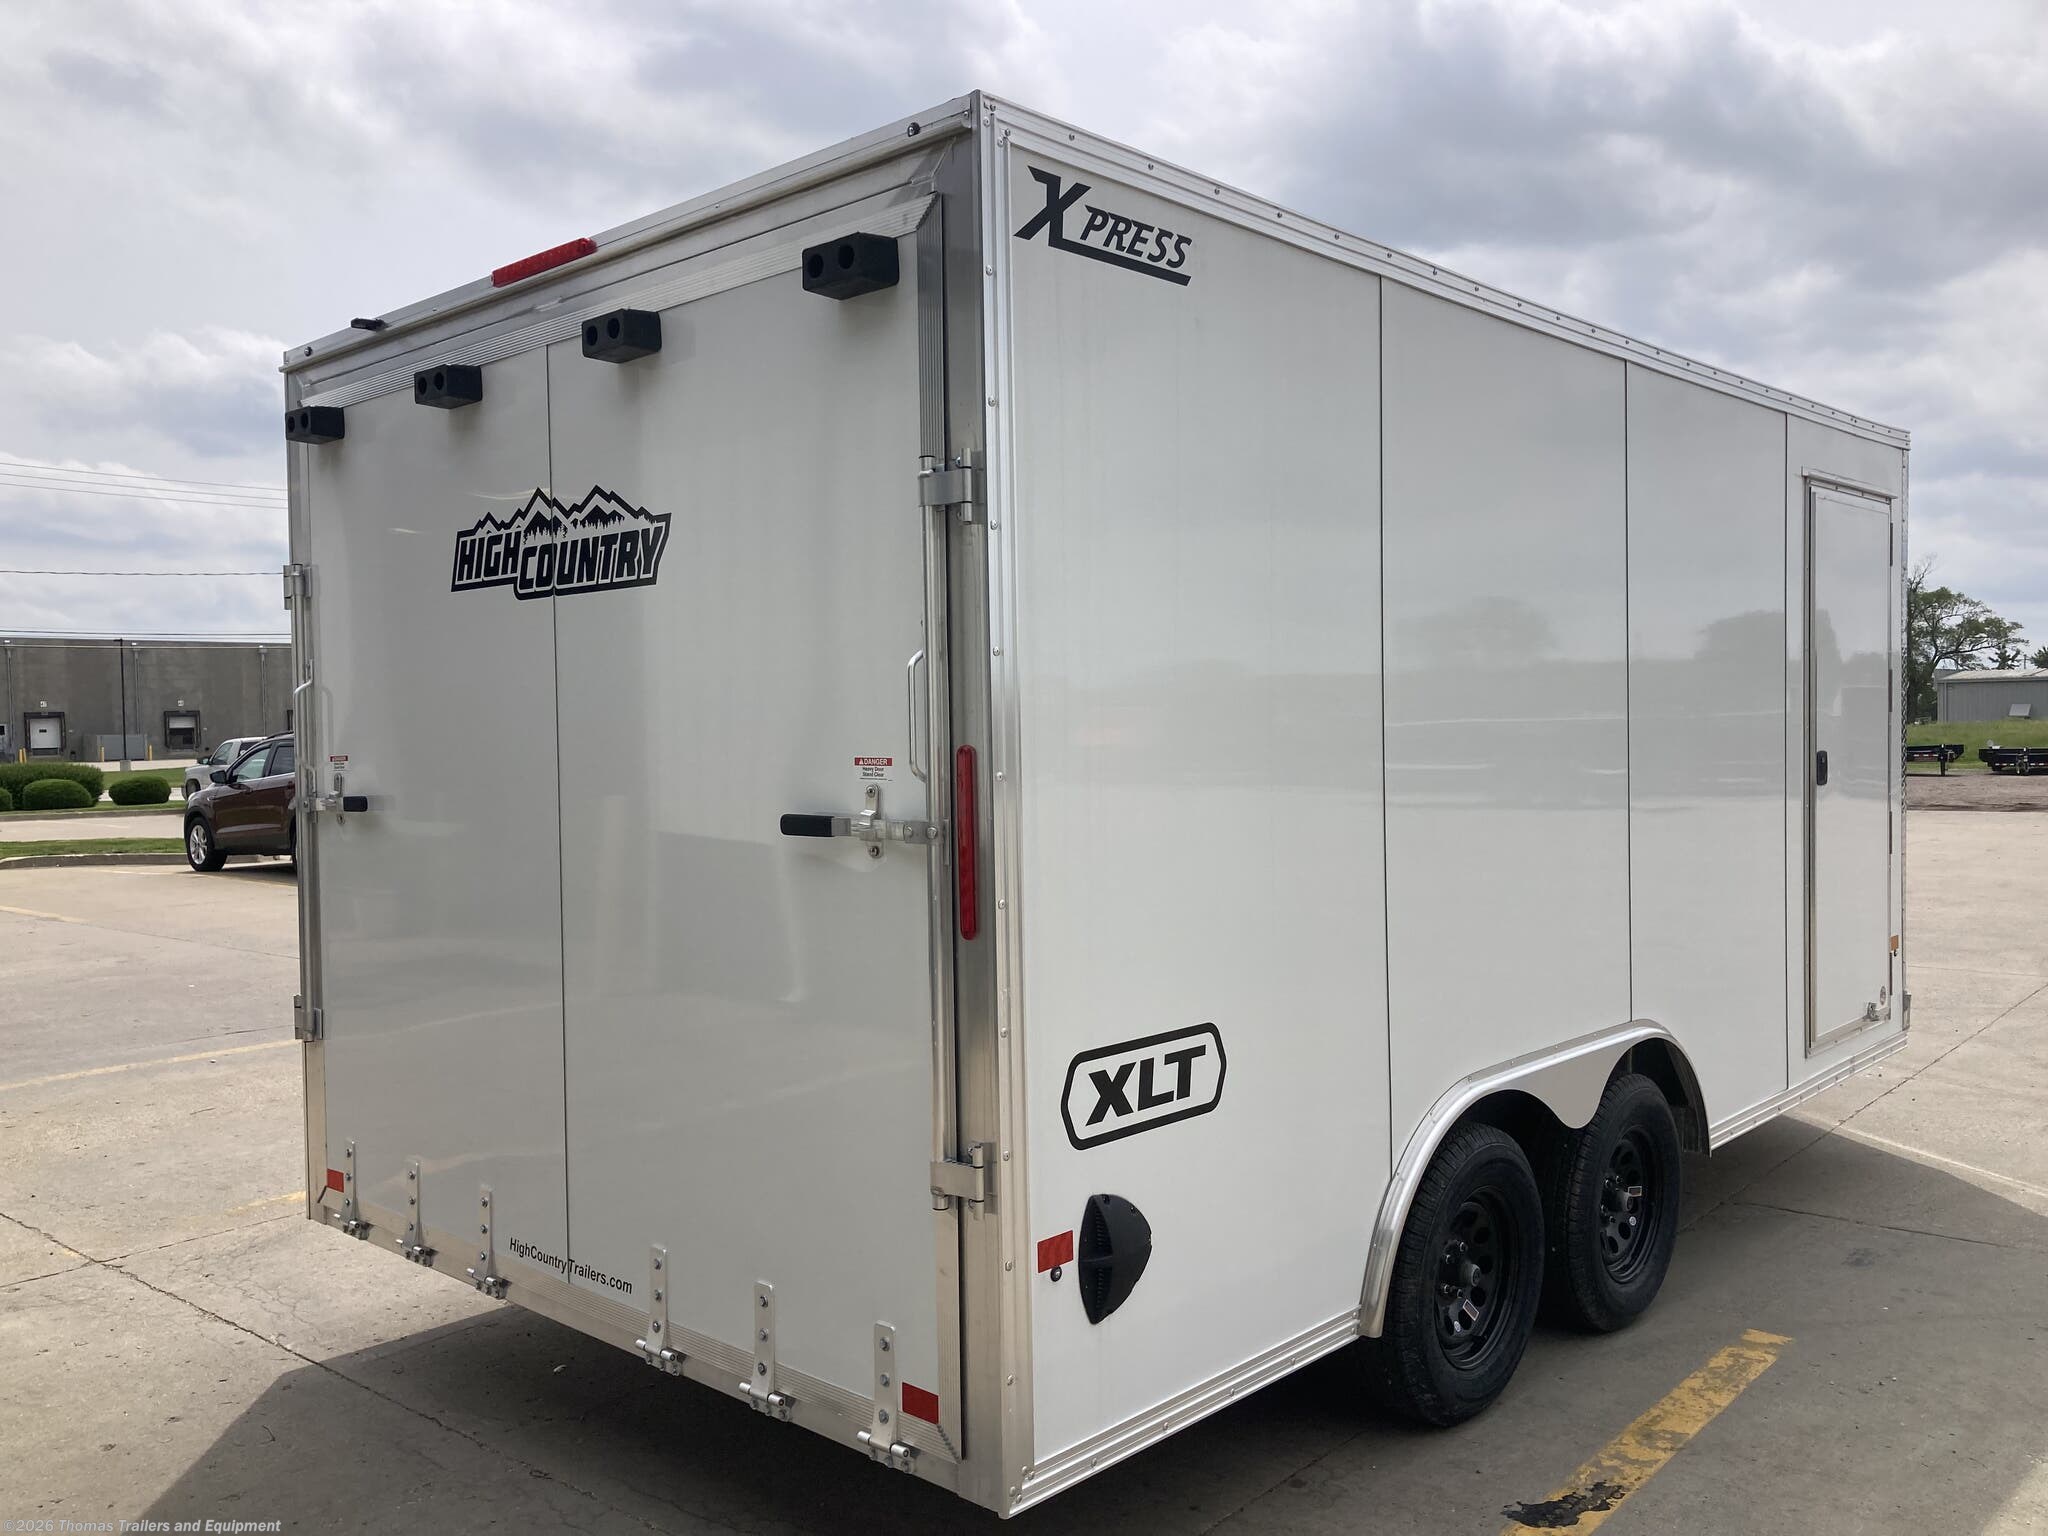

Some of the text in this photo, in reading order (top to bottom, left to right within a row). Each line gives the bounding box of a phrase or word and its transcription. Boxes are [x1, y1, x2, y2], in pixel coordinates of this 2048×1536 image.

[456, 525, 664, 591] HIGH COUNTRY
[864, 758, 888, 766] DANGER
[1085, 1044, 1207, 1127] XLT
[509, 1237, 633, 1295] HighCountryTrailers.com
